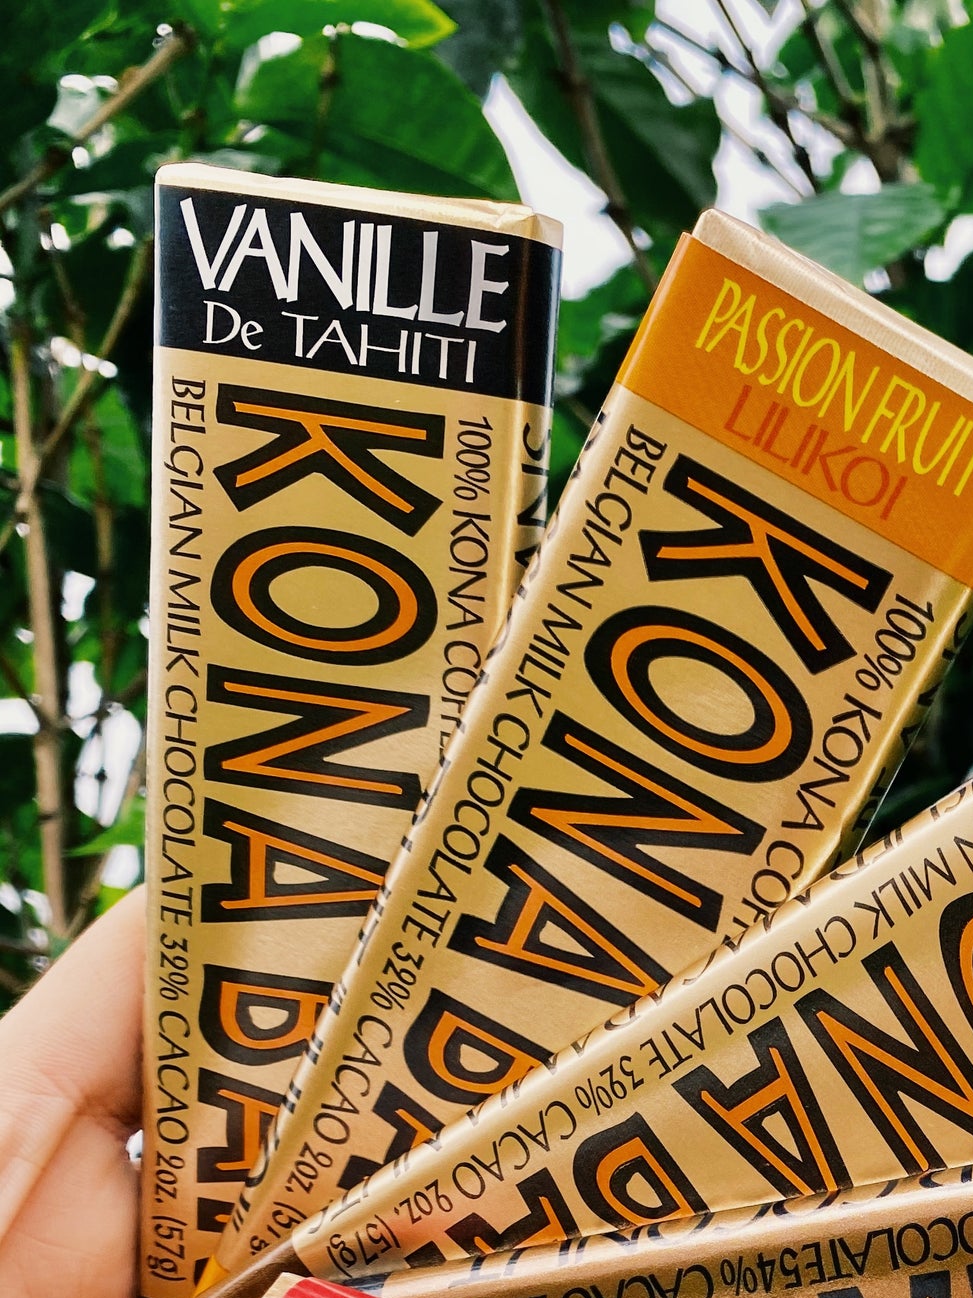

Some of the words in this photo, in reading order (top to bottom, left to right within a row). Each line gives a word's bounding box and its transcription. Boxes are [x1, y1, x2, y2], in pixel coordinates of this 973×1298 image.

[181, 198, 509, 333] VANILLE
[203, 301, 264, 349] De
[281, 311, 477, 382] TAHITI
[695, 278, 880, 432] PASSION
[165, 376, 206, 560] BELGIAN
[453, 416, 492, 501] 100%
[724, 385, 907, 520] LILIKOI
[446, 510, 492, 630] KONA
[556, 424, 667, 609] BELGIAN
[166, 570, 203, 678] MILK
[201, 384, 445, 923] KONA
[506, 603, 583, 718] MILK
[855, 593, 935, 691] 100%
[446, 453, 894, 1008] KONA
[781, 693, 882, 831] KONA
[160, 685, 197, 926] CHOCOLATE
[402, 712, 530, 948] CHOCOLATE
[854, 847, 957, 940] MILK
[158, 933, 190, 1001] 32%
[370, 942, 424, 1009] 32%
[639, 915, 857, 1079] CHOCOLATE
[157, 1010, 190, 1145] CACAO
[313, 1015, 393, 1144] CACAO
[575, 1055, 644, 1116] 32%
[452, 1100, 577, 1199] CACAO
[147, 1215, 188, 1282] (57g)
[326, 1215, 401, 1278] (57g)
[720, 1246, 802, 1296] 54%
